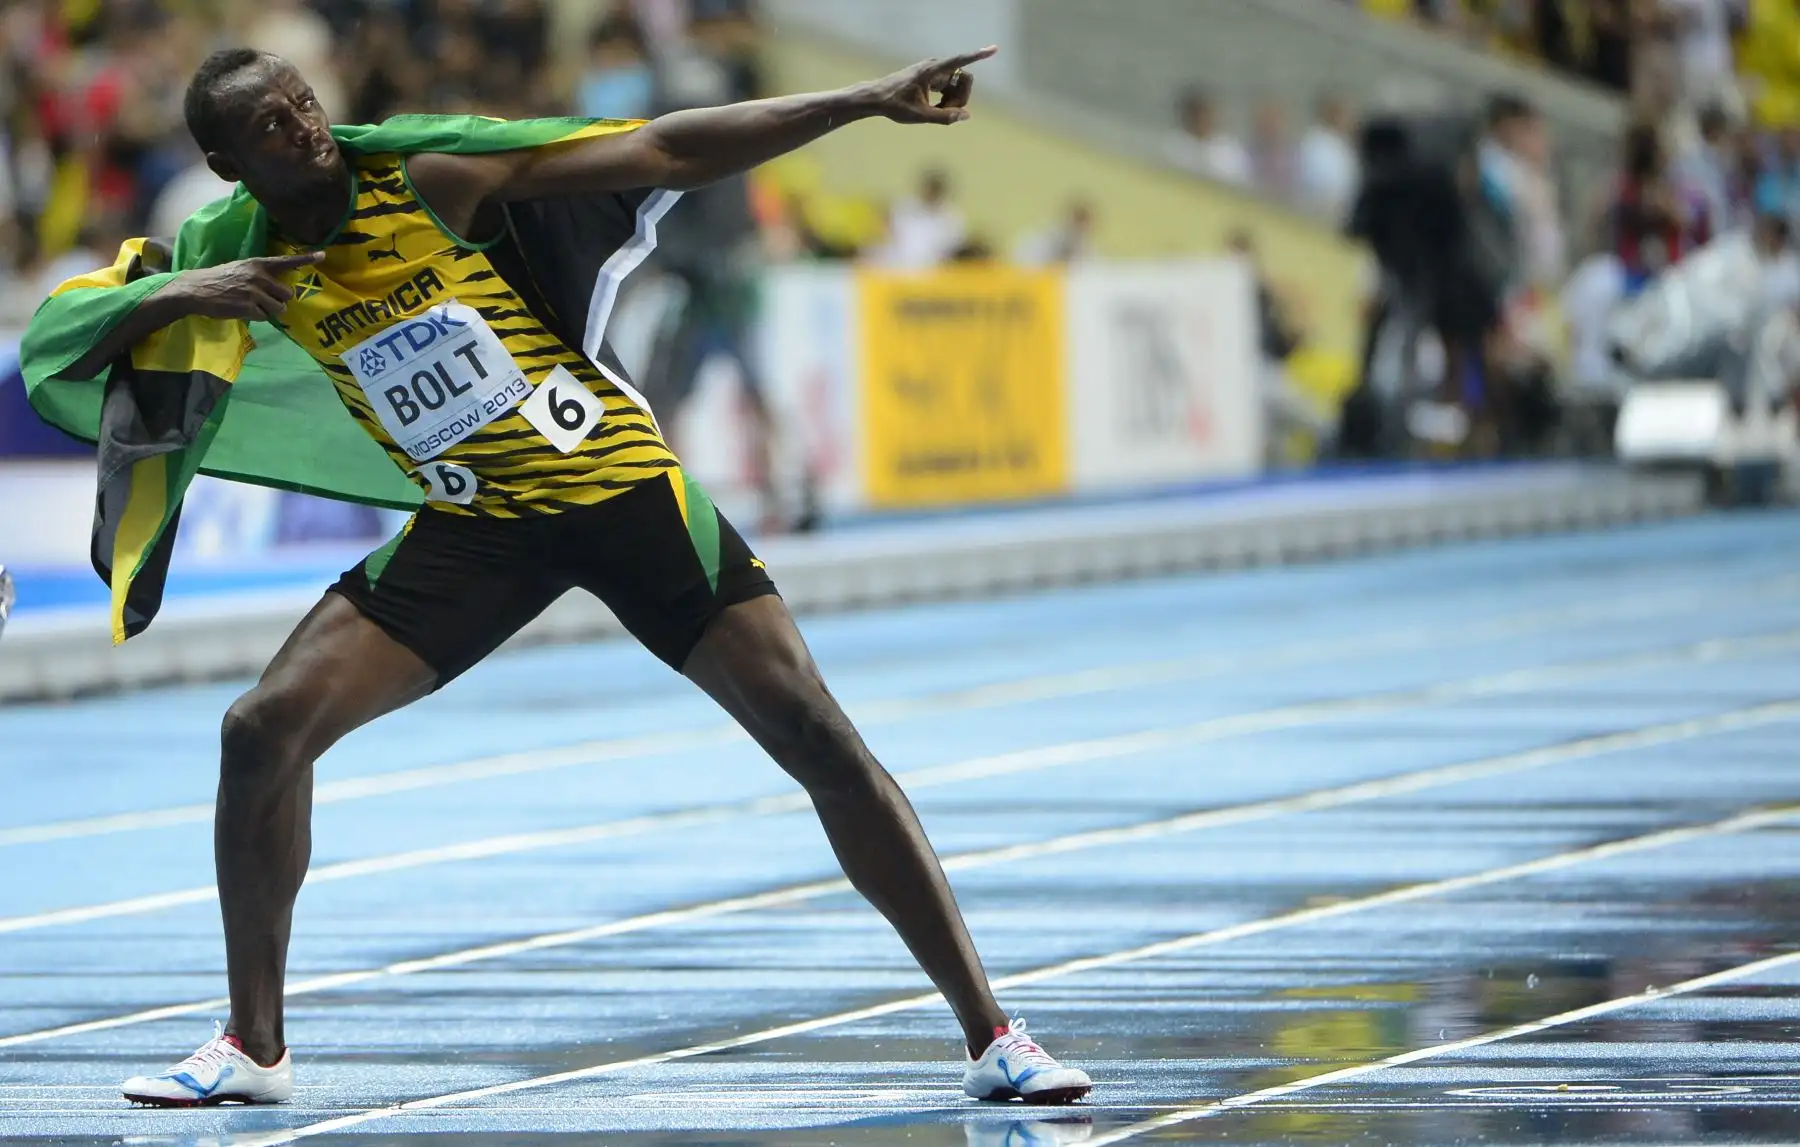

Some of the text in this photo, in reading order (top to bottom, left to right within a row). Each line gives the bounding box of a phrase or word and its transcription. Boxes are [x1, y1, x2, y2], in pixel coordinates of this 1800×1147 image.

[314, 267, 445, 348] JAMAICA
[375, 307, 468, 362] TDK
[384, 339, 489, 427] BOLT
[548, 386, 586, 431] 6
[406, 378, 526, 457] MOSCOW 2013
[435, 464, 467, 496] 6
